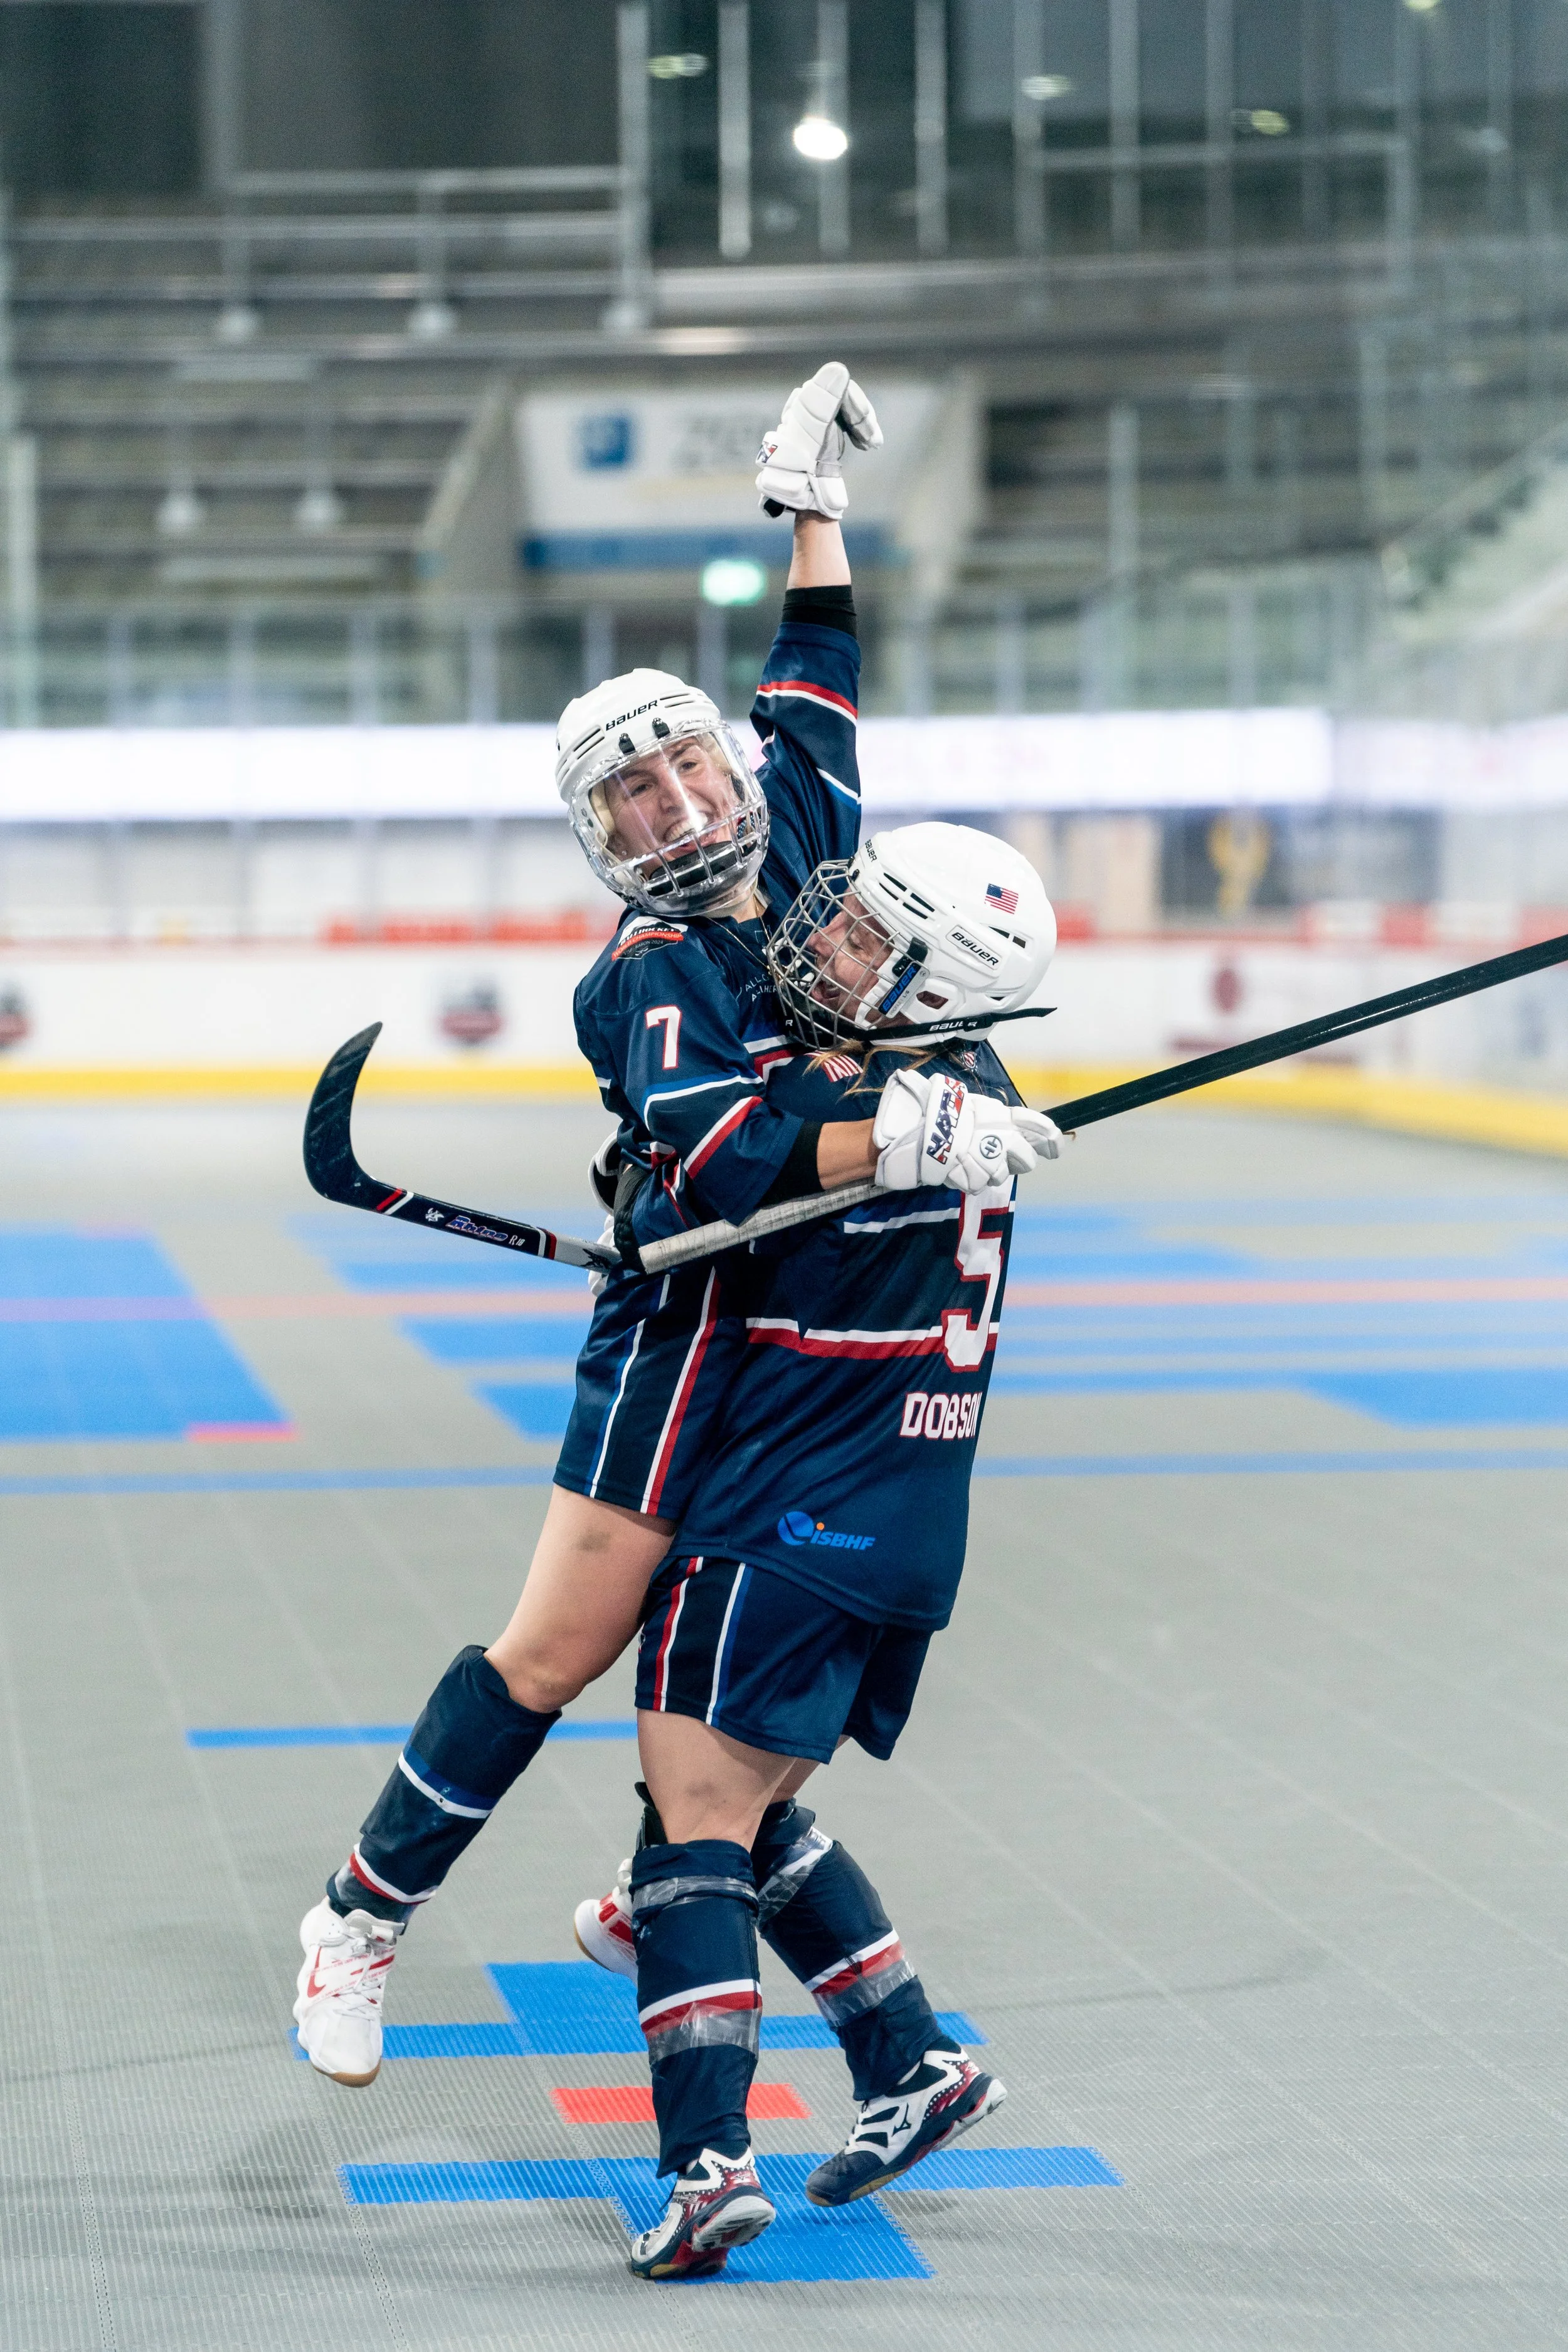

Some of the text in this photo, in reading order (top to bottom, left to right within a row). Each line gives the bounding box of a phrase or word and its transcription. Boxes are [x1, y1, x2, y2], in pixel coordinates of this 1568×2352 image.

[605, 699, 658, 731] BAUER
[951, 932, 999, 966] BAUER
[882, 966, 916, 1012] BAUER
[645, 1004, 682, 1071] 7
[941, 1175, 1015, 1373] 5
[899, 1391, 983, 1441] DOBSON
